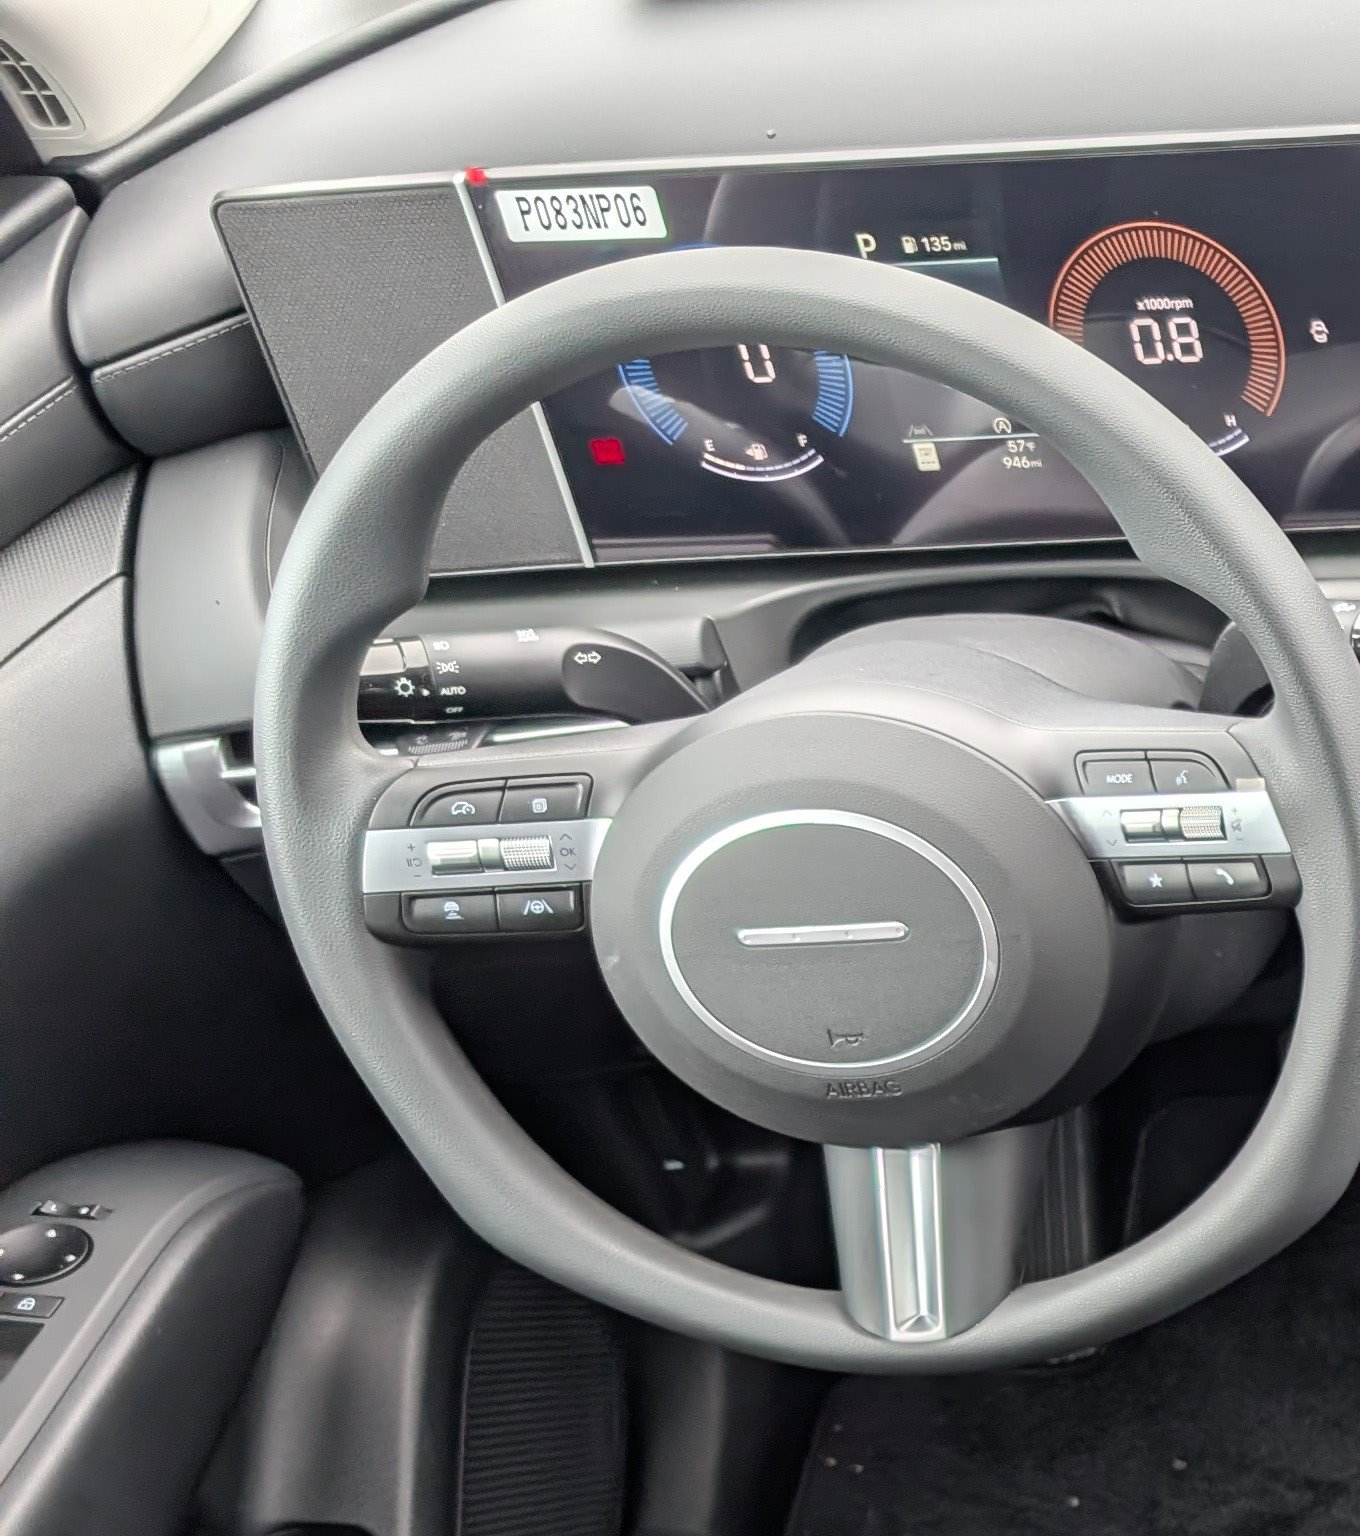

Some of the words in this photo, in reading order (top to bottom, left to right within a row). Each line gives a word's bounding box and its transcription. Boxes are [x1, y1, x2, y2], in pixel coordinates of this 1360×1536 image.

[855, 232, 877, 260] P
[1130, 316, 1204, 365] 0.8
[704, 439, 716, 452] E
[440, 685, 467, 696] AUTO
[1106, 773, 1133, 784] MODE
[560, 847, 577, 857] OK
[825, 1080, 902, 1100] AIRBAG
